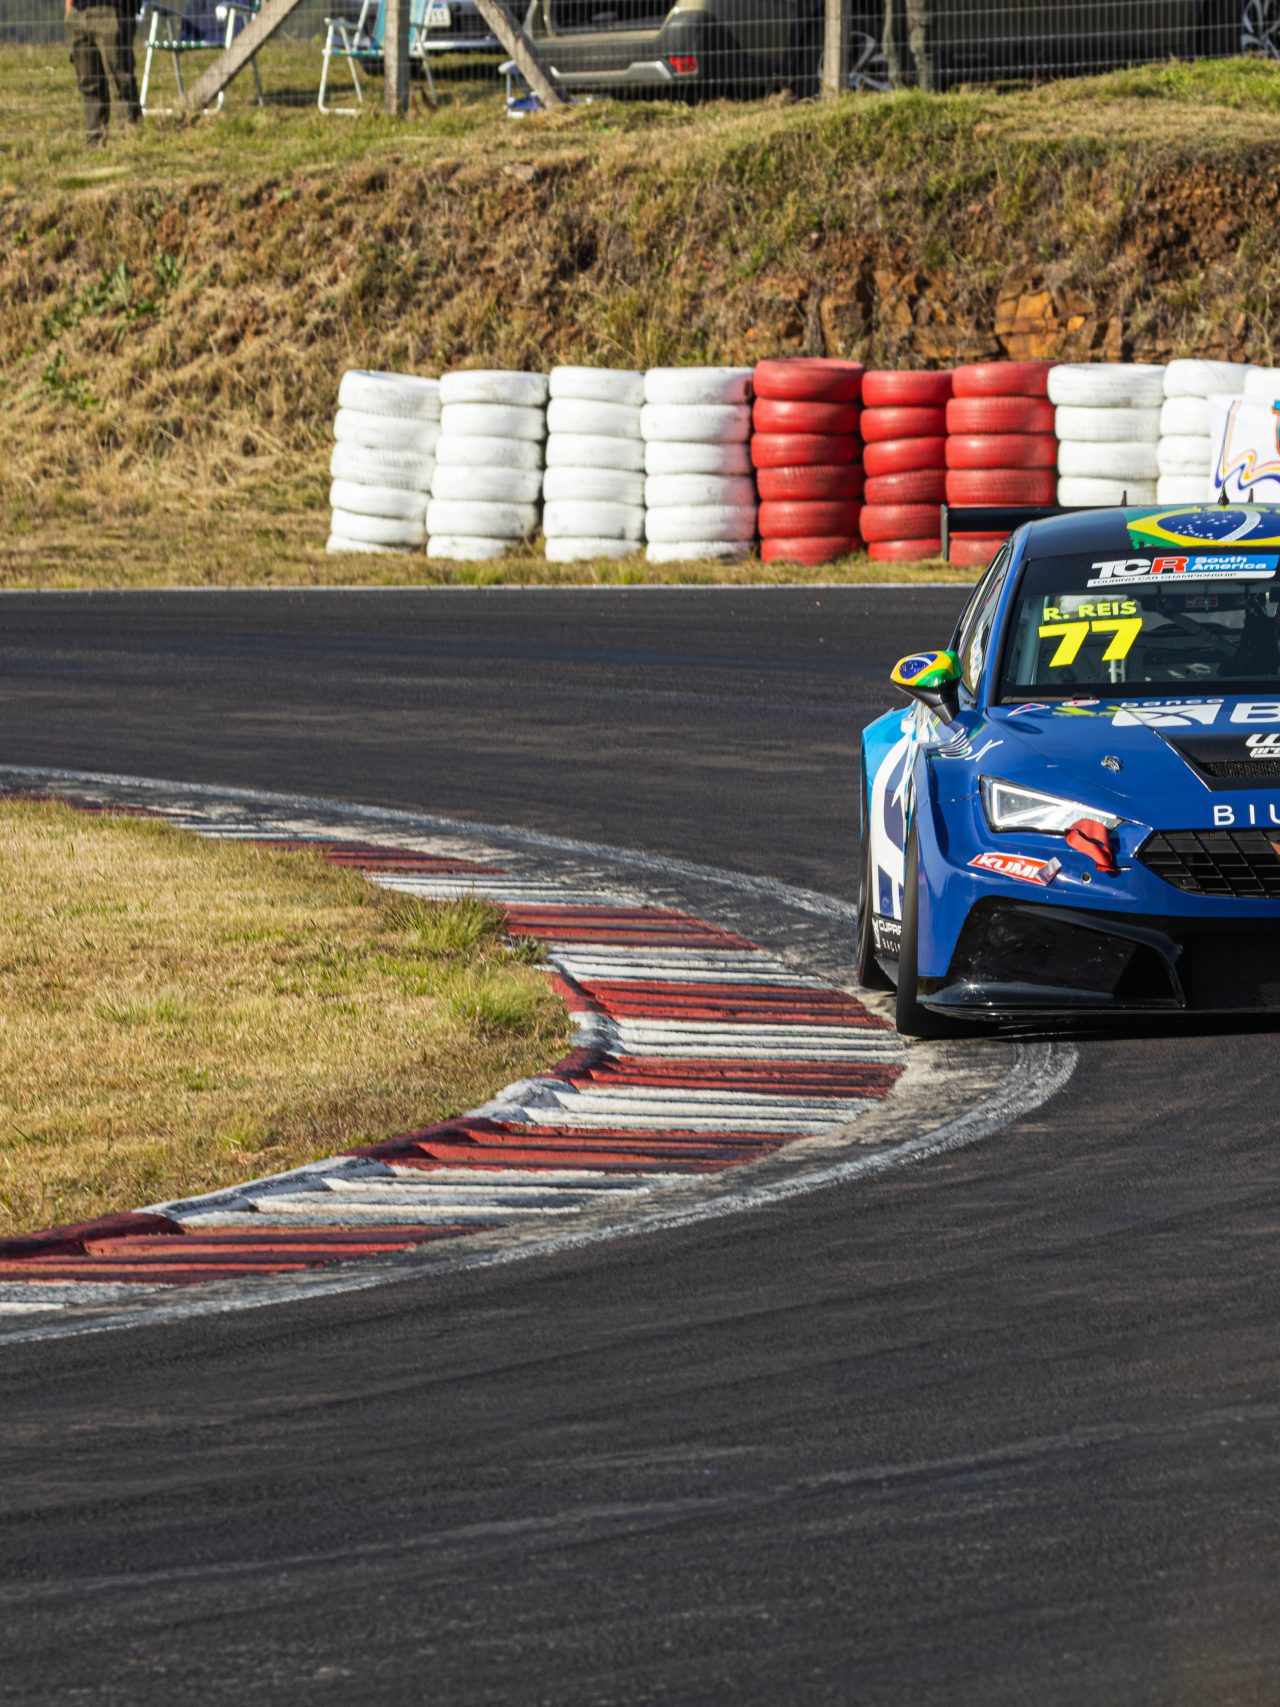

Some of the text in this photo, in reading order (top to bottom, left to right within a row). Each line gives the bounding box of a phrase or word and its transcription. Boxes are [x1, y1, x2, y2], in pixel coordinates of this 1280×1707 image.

[1091, 556, 1189, 579] TCR
[1191, 562, 1267, 571] America
[1194, 556, 1248, 564] South
[1043, 601, 1137, 621] R. REIS
[1039, 617, 1142, 668] 77
